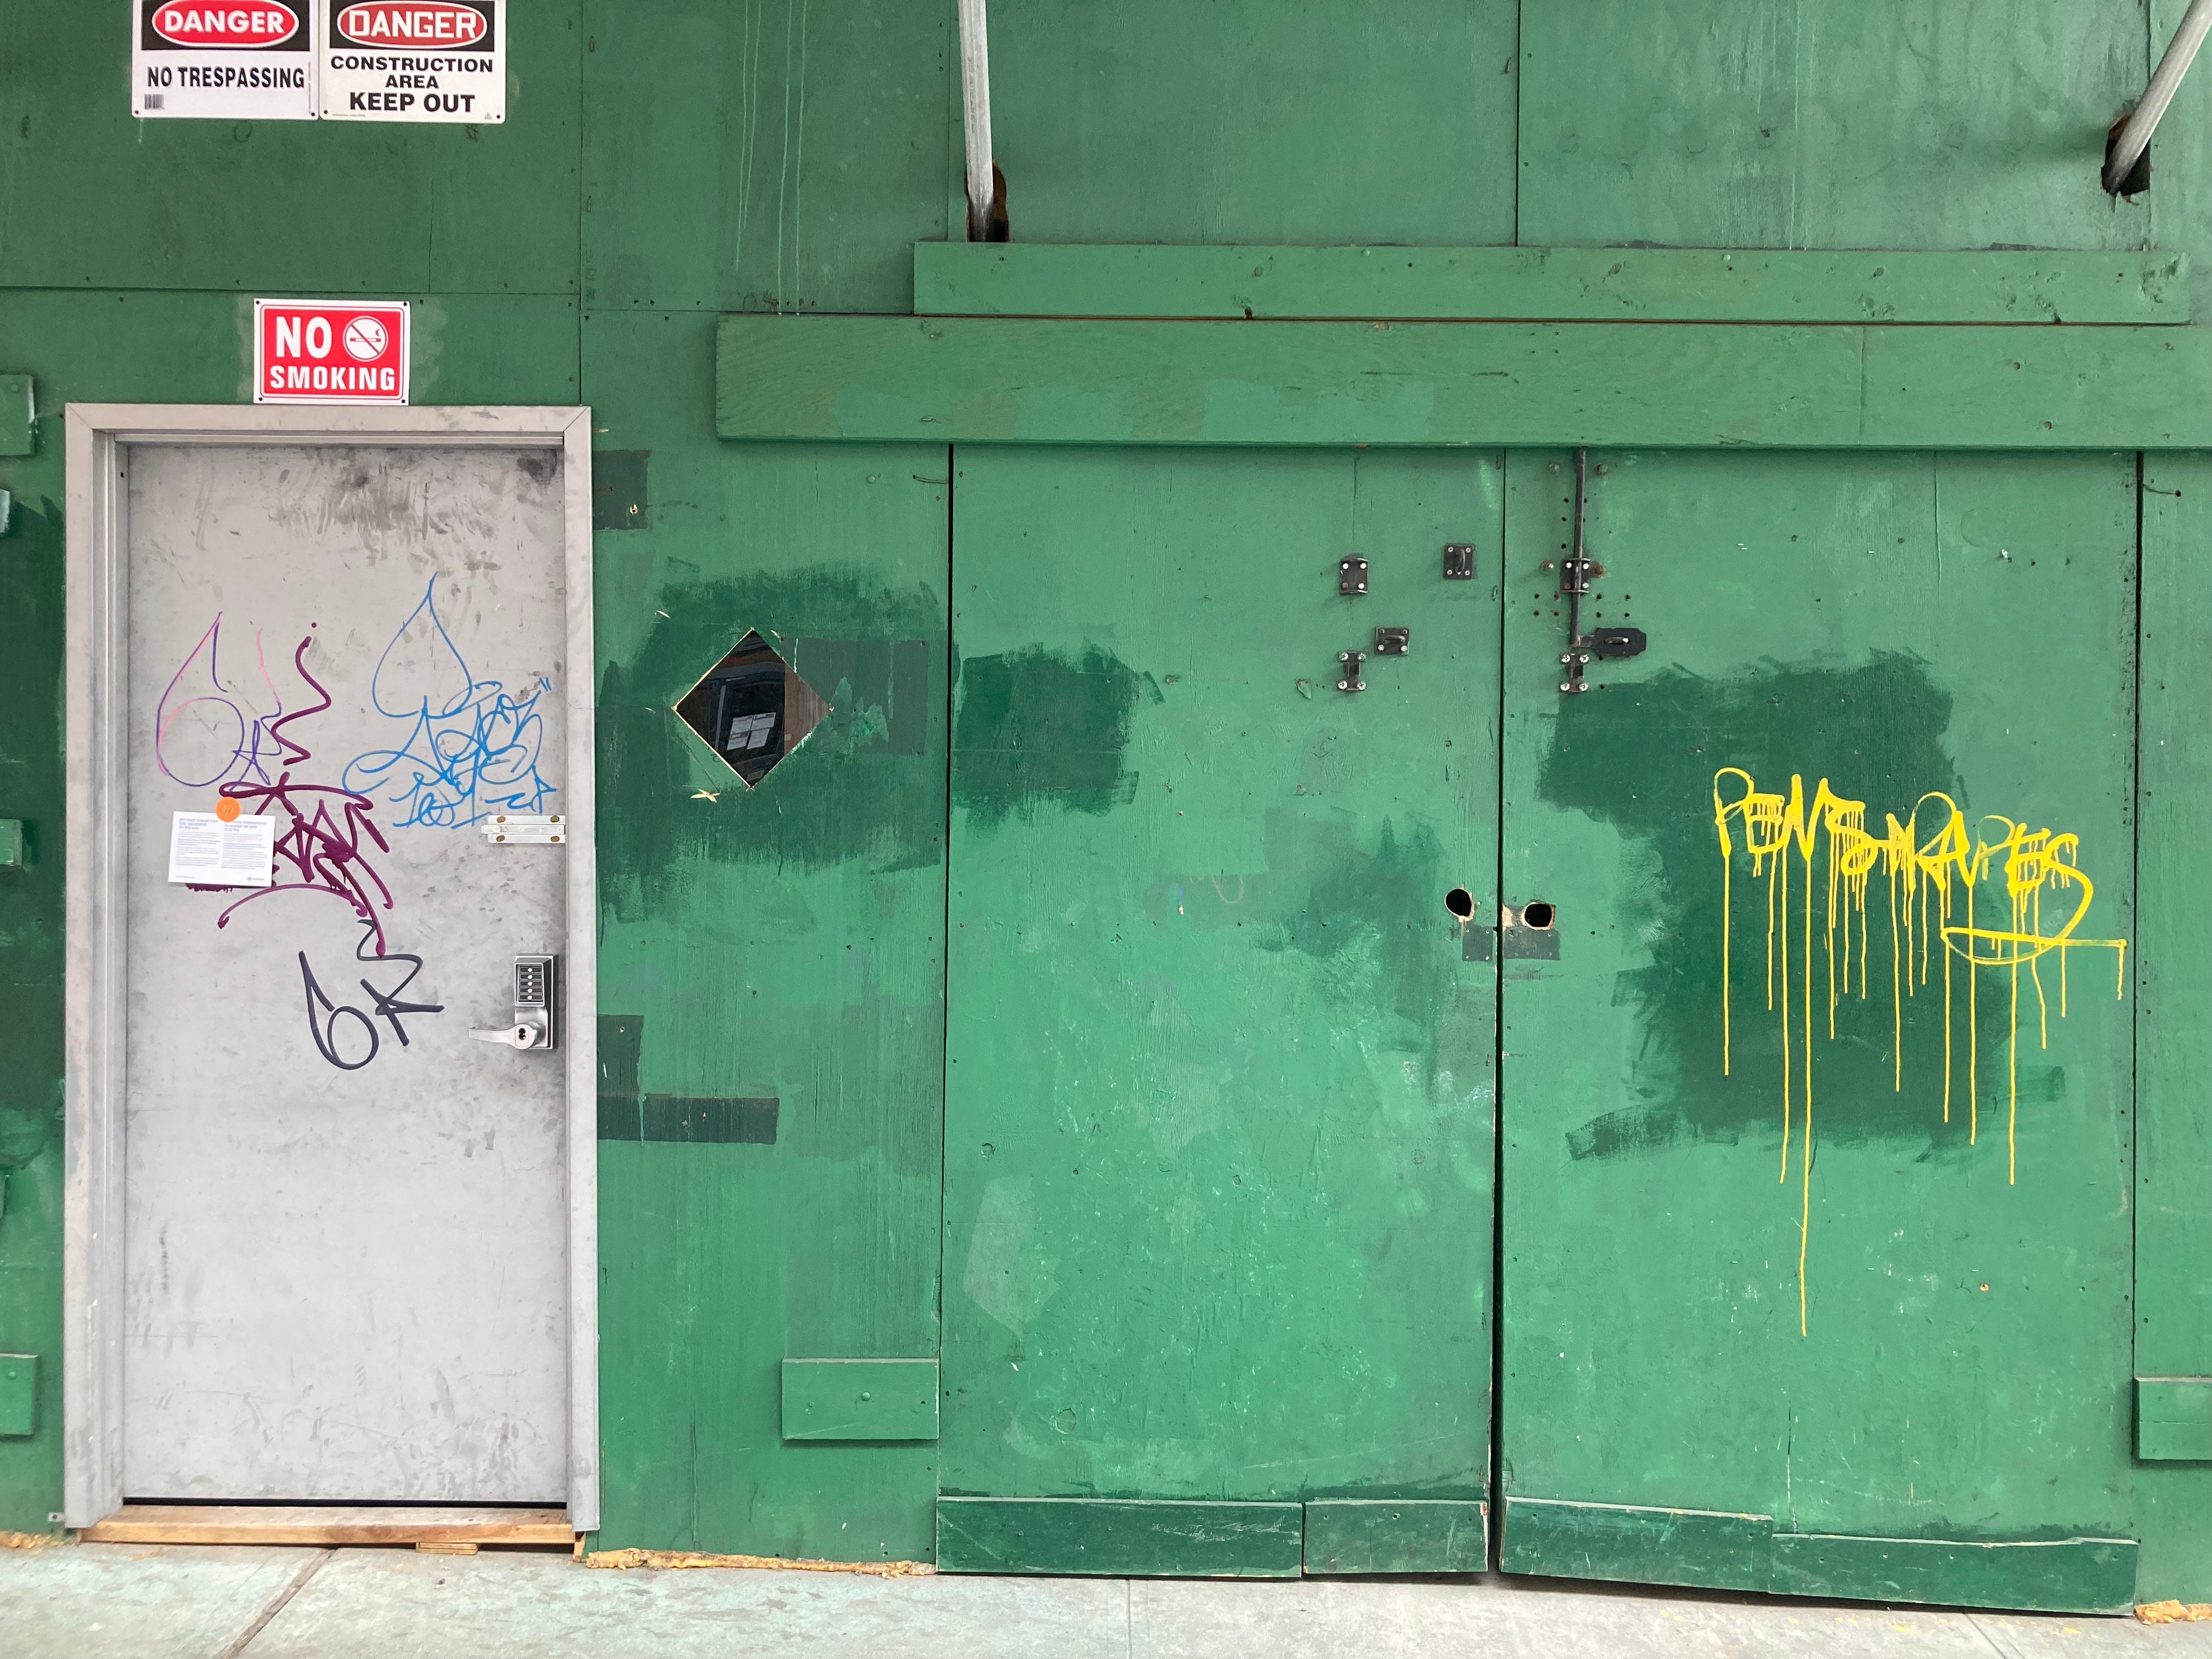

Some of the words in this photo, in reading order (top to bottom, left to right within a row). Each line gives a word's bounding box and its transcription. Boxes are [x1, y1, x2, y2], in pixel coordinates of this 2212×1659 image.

[164, 10, 285, 34] DANGER
[348, 10, 477, 39] DANGER
[330, 56, 493, 72] CONSTRUCTION
[146, 66, 172, 87] NO
[177, 66, 304, 88] TRESPASSING
[385, 75, 439, 89] AREA
[349, 92, 415, 111] KEEP
[424, 94, 476, 112] OUT
[275, 315, 332, 359] NO
[269, 365, 396, 391] SMOKING
